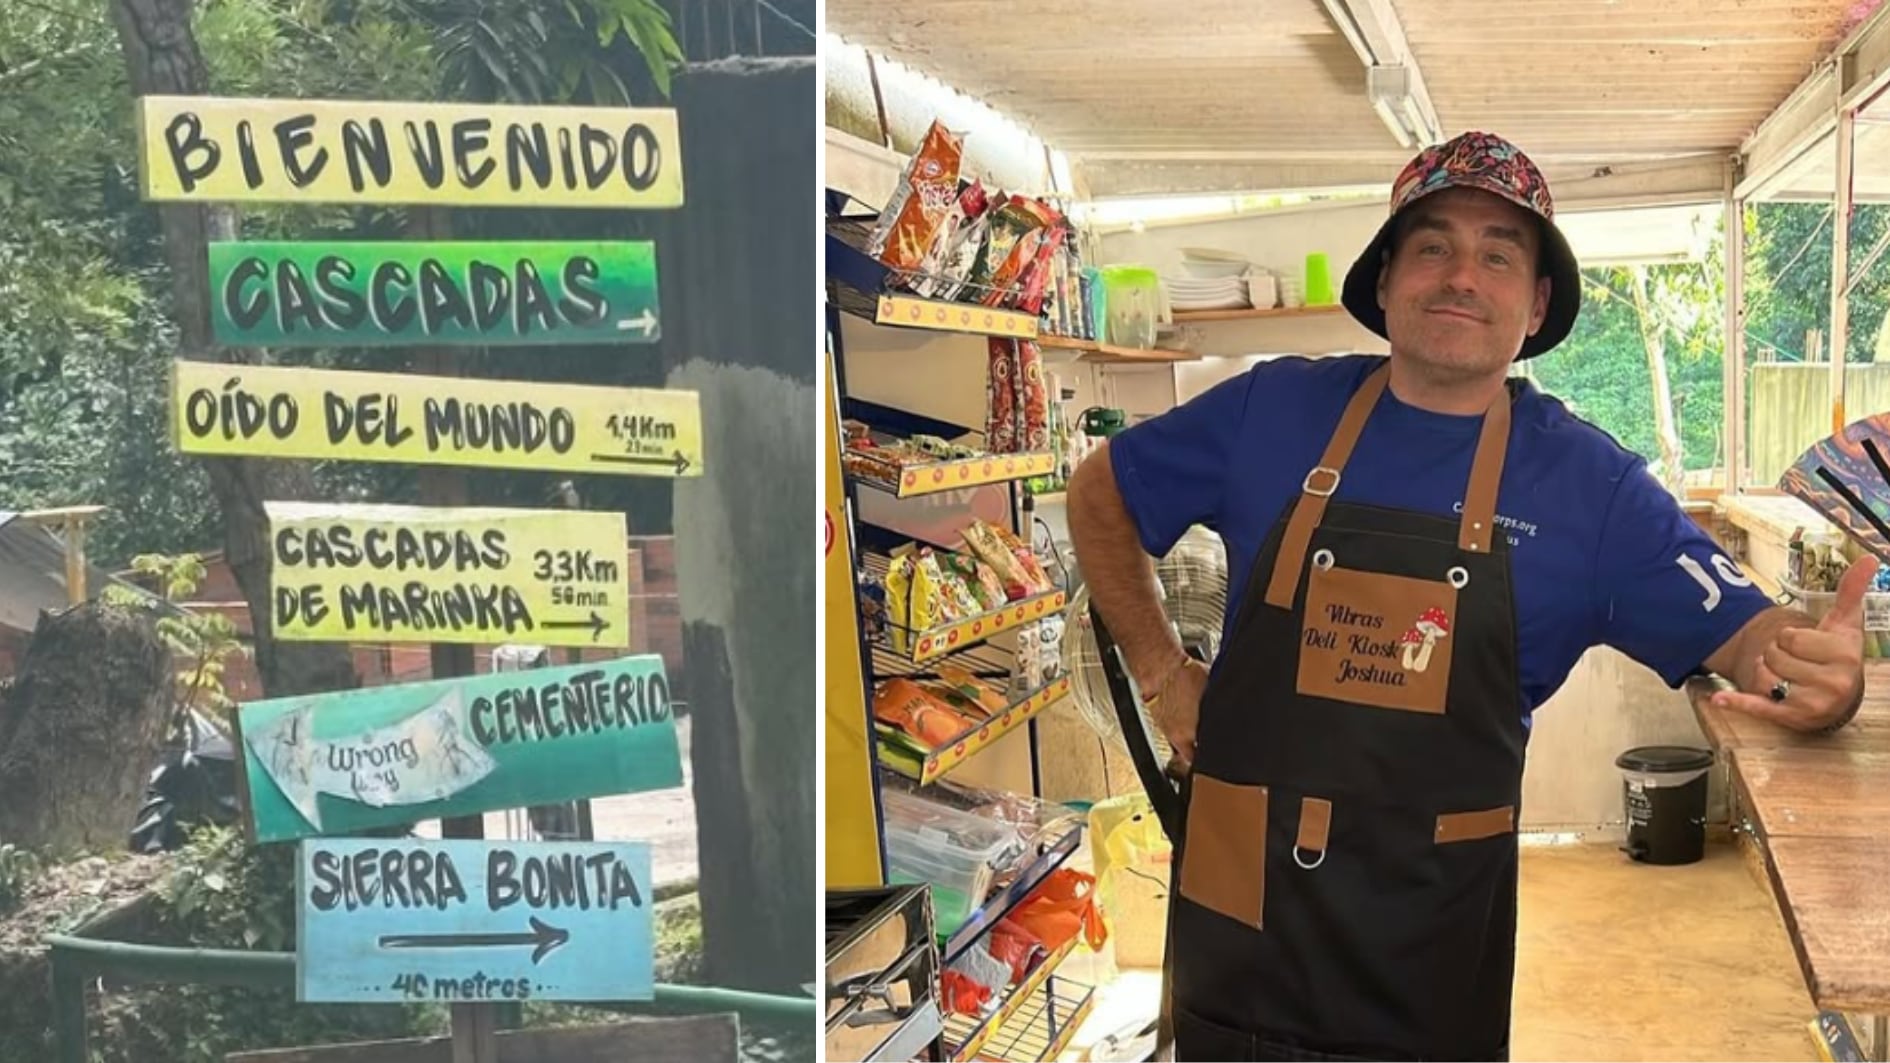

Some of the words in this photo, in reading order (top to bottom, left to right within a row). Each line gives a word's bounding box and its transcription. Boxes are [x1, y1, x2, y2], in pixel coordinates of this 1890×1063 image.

[164, 111, 660, 192] BIENVENIDO
[223, 255, 607, 335] CASCADAS
[185, 378, 298, 440] OÍDO
[324, 390, 413, 446] DEL
[423, 397, 575, 454] MUNDO
[275, 526, 511, 571] CASCADAS
[276, 584, 330, 629] DE
[339, 581, 534, 633] MARINKA
[1325, 604, 1384, 630] Vibras
[1304, 628, 1338, 650] Deli
[1347, 634, 1402, 659] Kiosk
[1335, 660, 1407, 687] Joshua
[469, 669, 669, 747] CEMENTERIO
[310, 848, 467, 911] SIERRA
[486, 851, 642, 911] BONITA
[433, 970, 531, 999] metros
